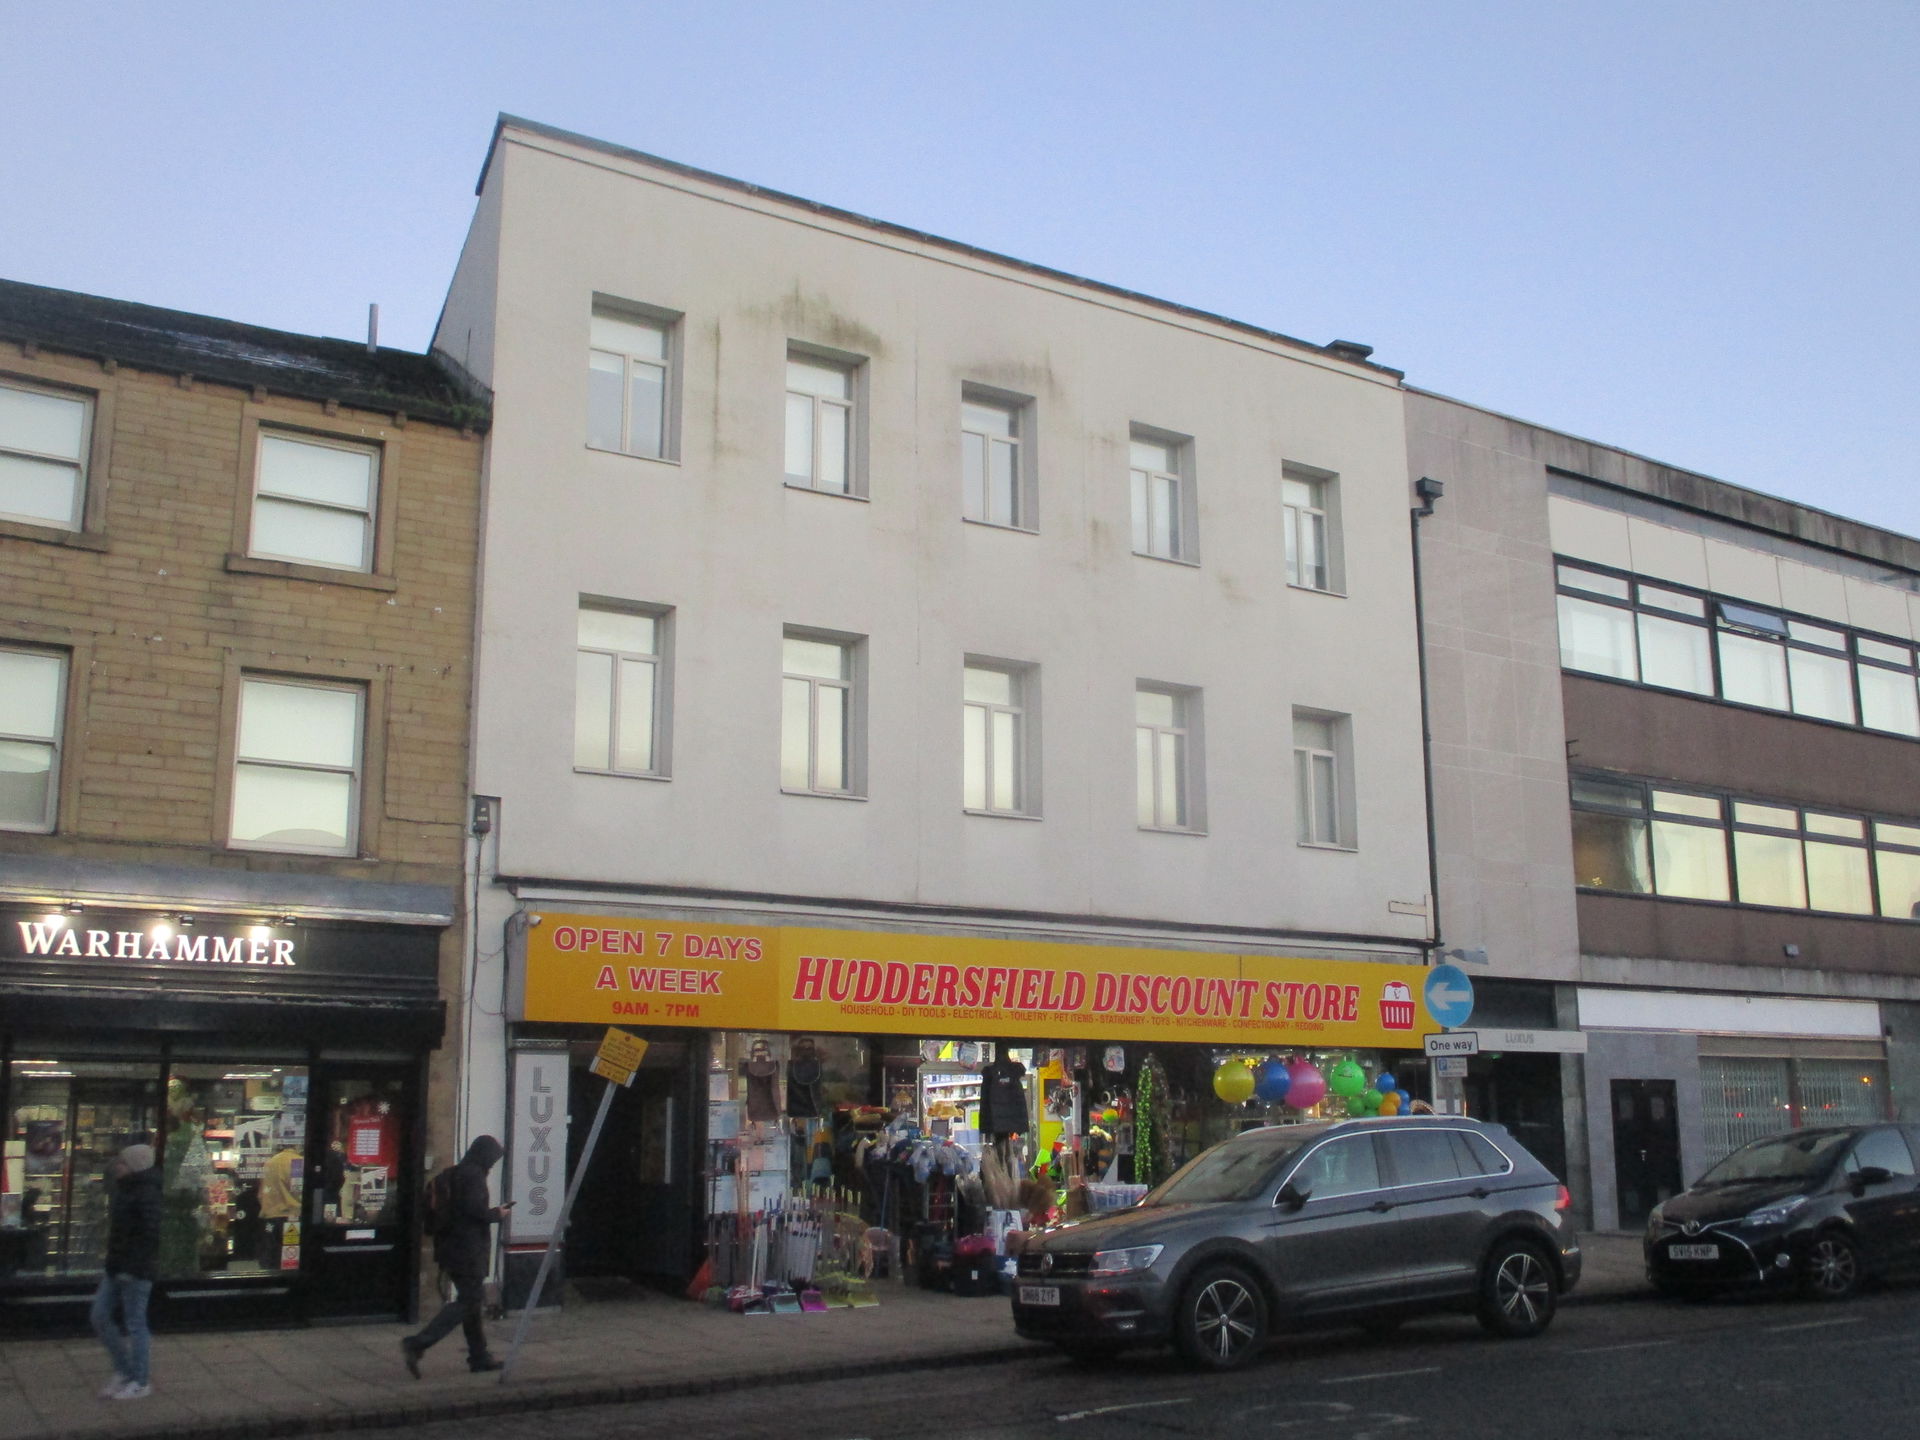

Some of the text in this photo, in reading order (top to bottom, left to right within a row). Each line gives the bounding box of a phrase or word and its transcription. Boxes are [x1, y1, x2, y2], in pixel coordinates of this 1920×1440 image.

[17, 921, 296, 966] WARHAMMER
[554, 927, 762, 961] OPEN 7 DAYS
[596, 966, 721, 994] A WEEK
[792, 957, 1360, 1022] HUDDERSFIELD DISCOUNT STORE
[612, 1001, 649, 1016] 9AM
[666, 1003, 700, 1018] 7PM
[840, 1004, 895, 1017] HOUSEHOLD
[902, 1007, 916, 1017] DIY
[916, 1007, 946, 1018] TOOLS
[952, 1008, 1003, 1021] ELECTRICAL
[1010, 1011, 1047, 1022] TOILETRY
[1054, 1013, 1068, 1023] PET
[1070, 1014, 1094, 1024] ITEMS
[1100, 1014, 1146, 1025] STATIONERY
[1152, 1016, 1170, 1026] TOYS
[1176, 1017, 1227, 1029] KITCHENWARE
[1295, 1021, 1324, 1032] BEDDING
[1430, 1040, 1472, 1051] One way
[528, 1067, 553, 1216] LUXUS
